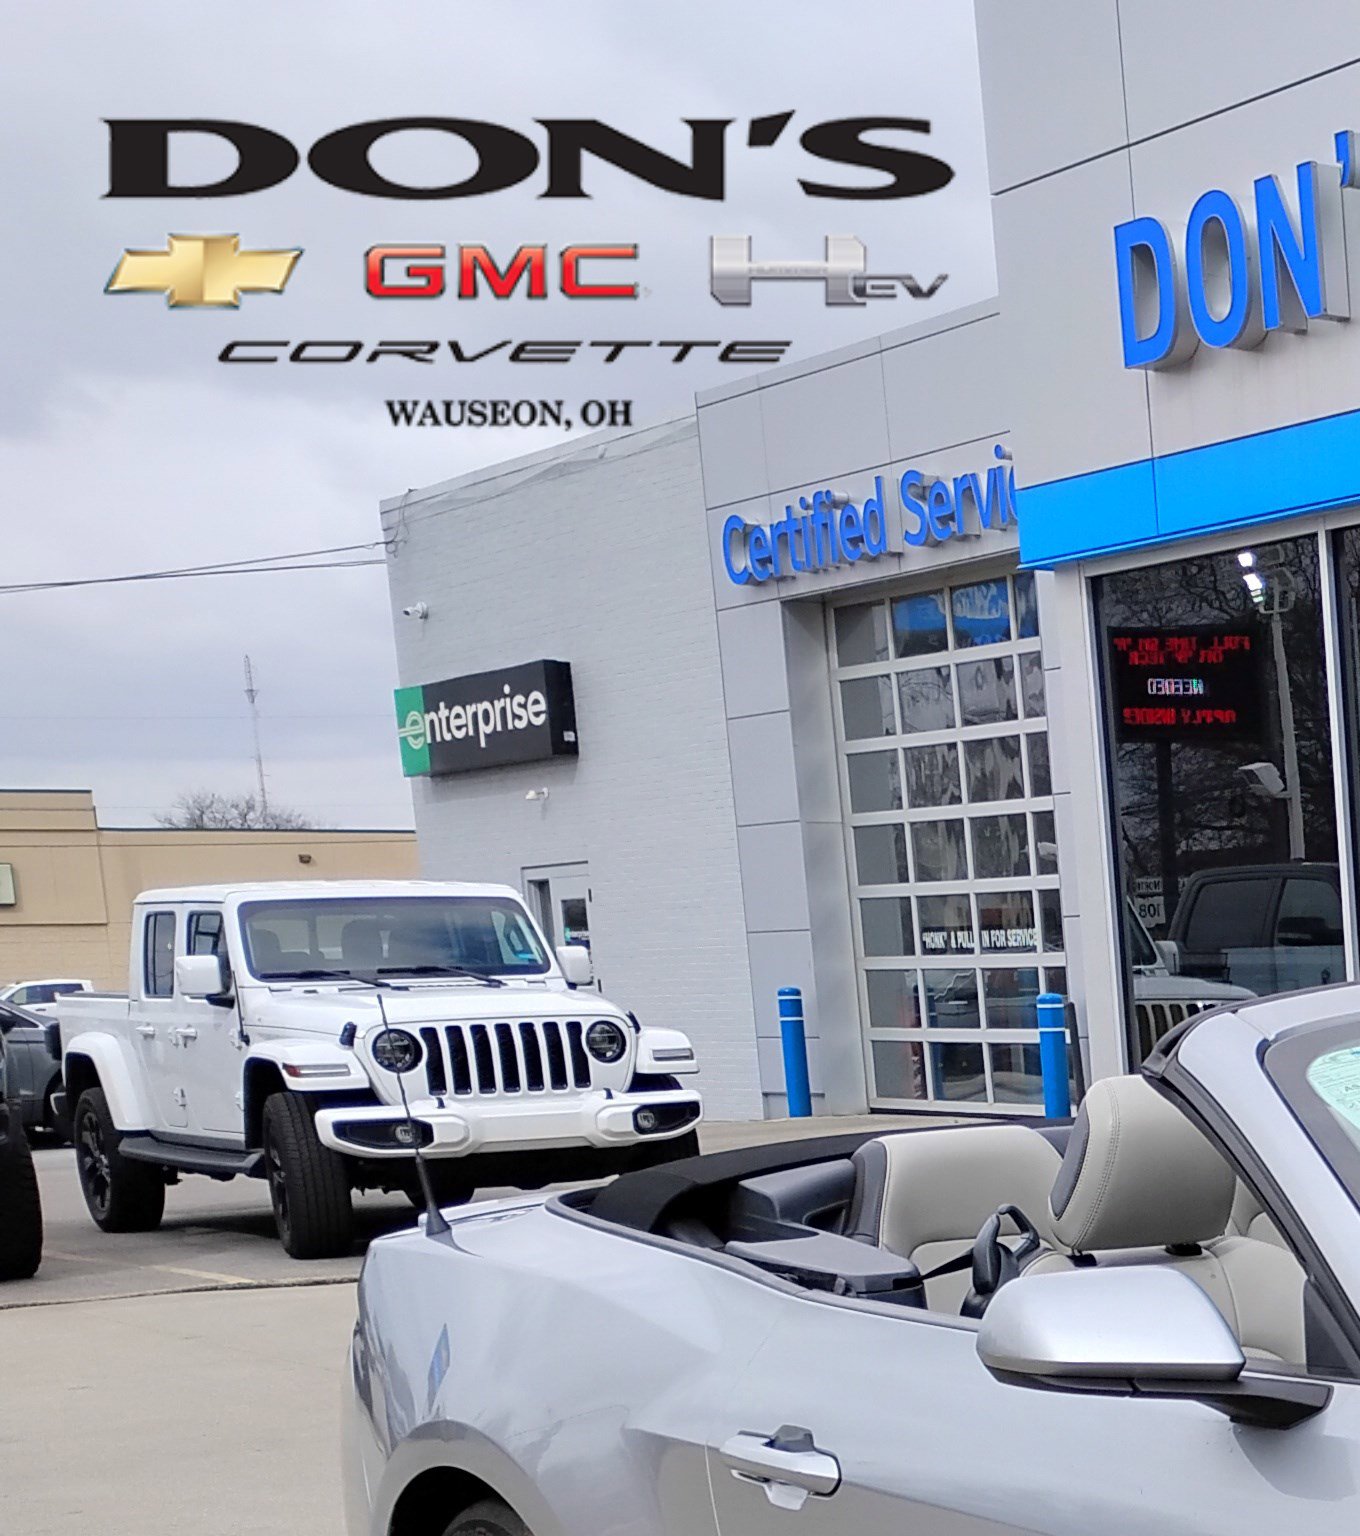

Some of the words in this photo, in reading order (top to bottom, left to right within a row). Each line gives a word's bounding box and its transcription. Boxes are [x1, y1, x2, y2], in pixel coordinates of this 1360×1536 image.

[722, 476, 888, 586] Certified
[398, 684, 547, 750] enterprise
[957, 930, 975, 948] PULL
[981, 930, 990, 948] IN
[991, 929, 1006, 947] FOR
